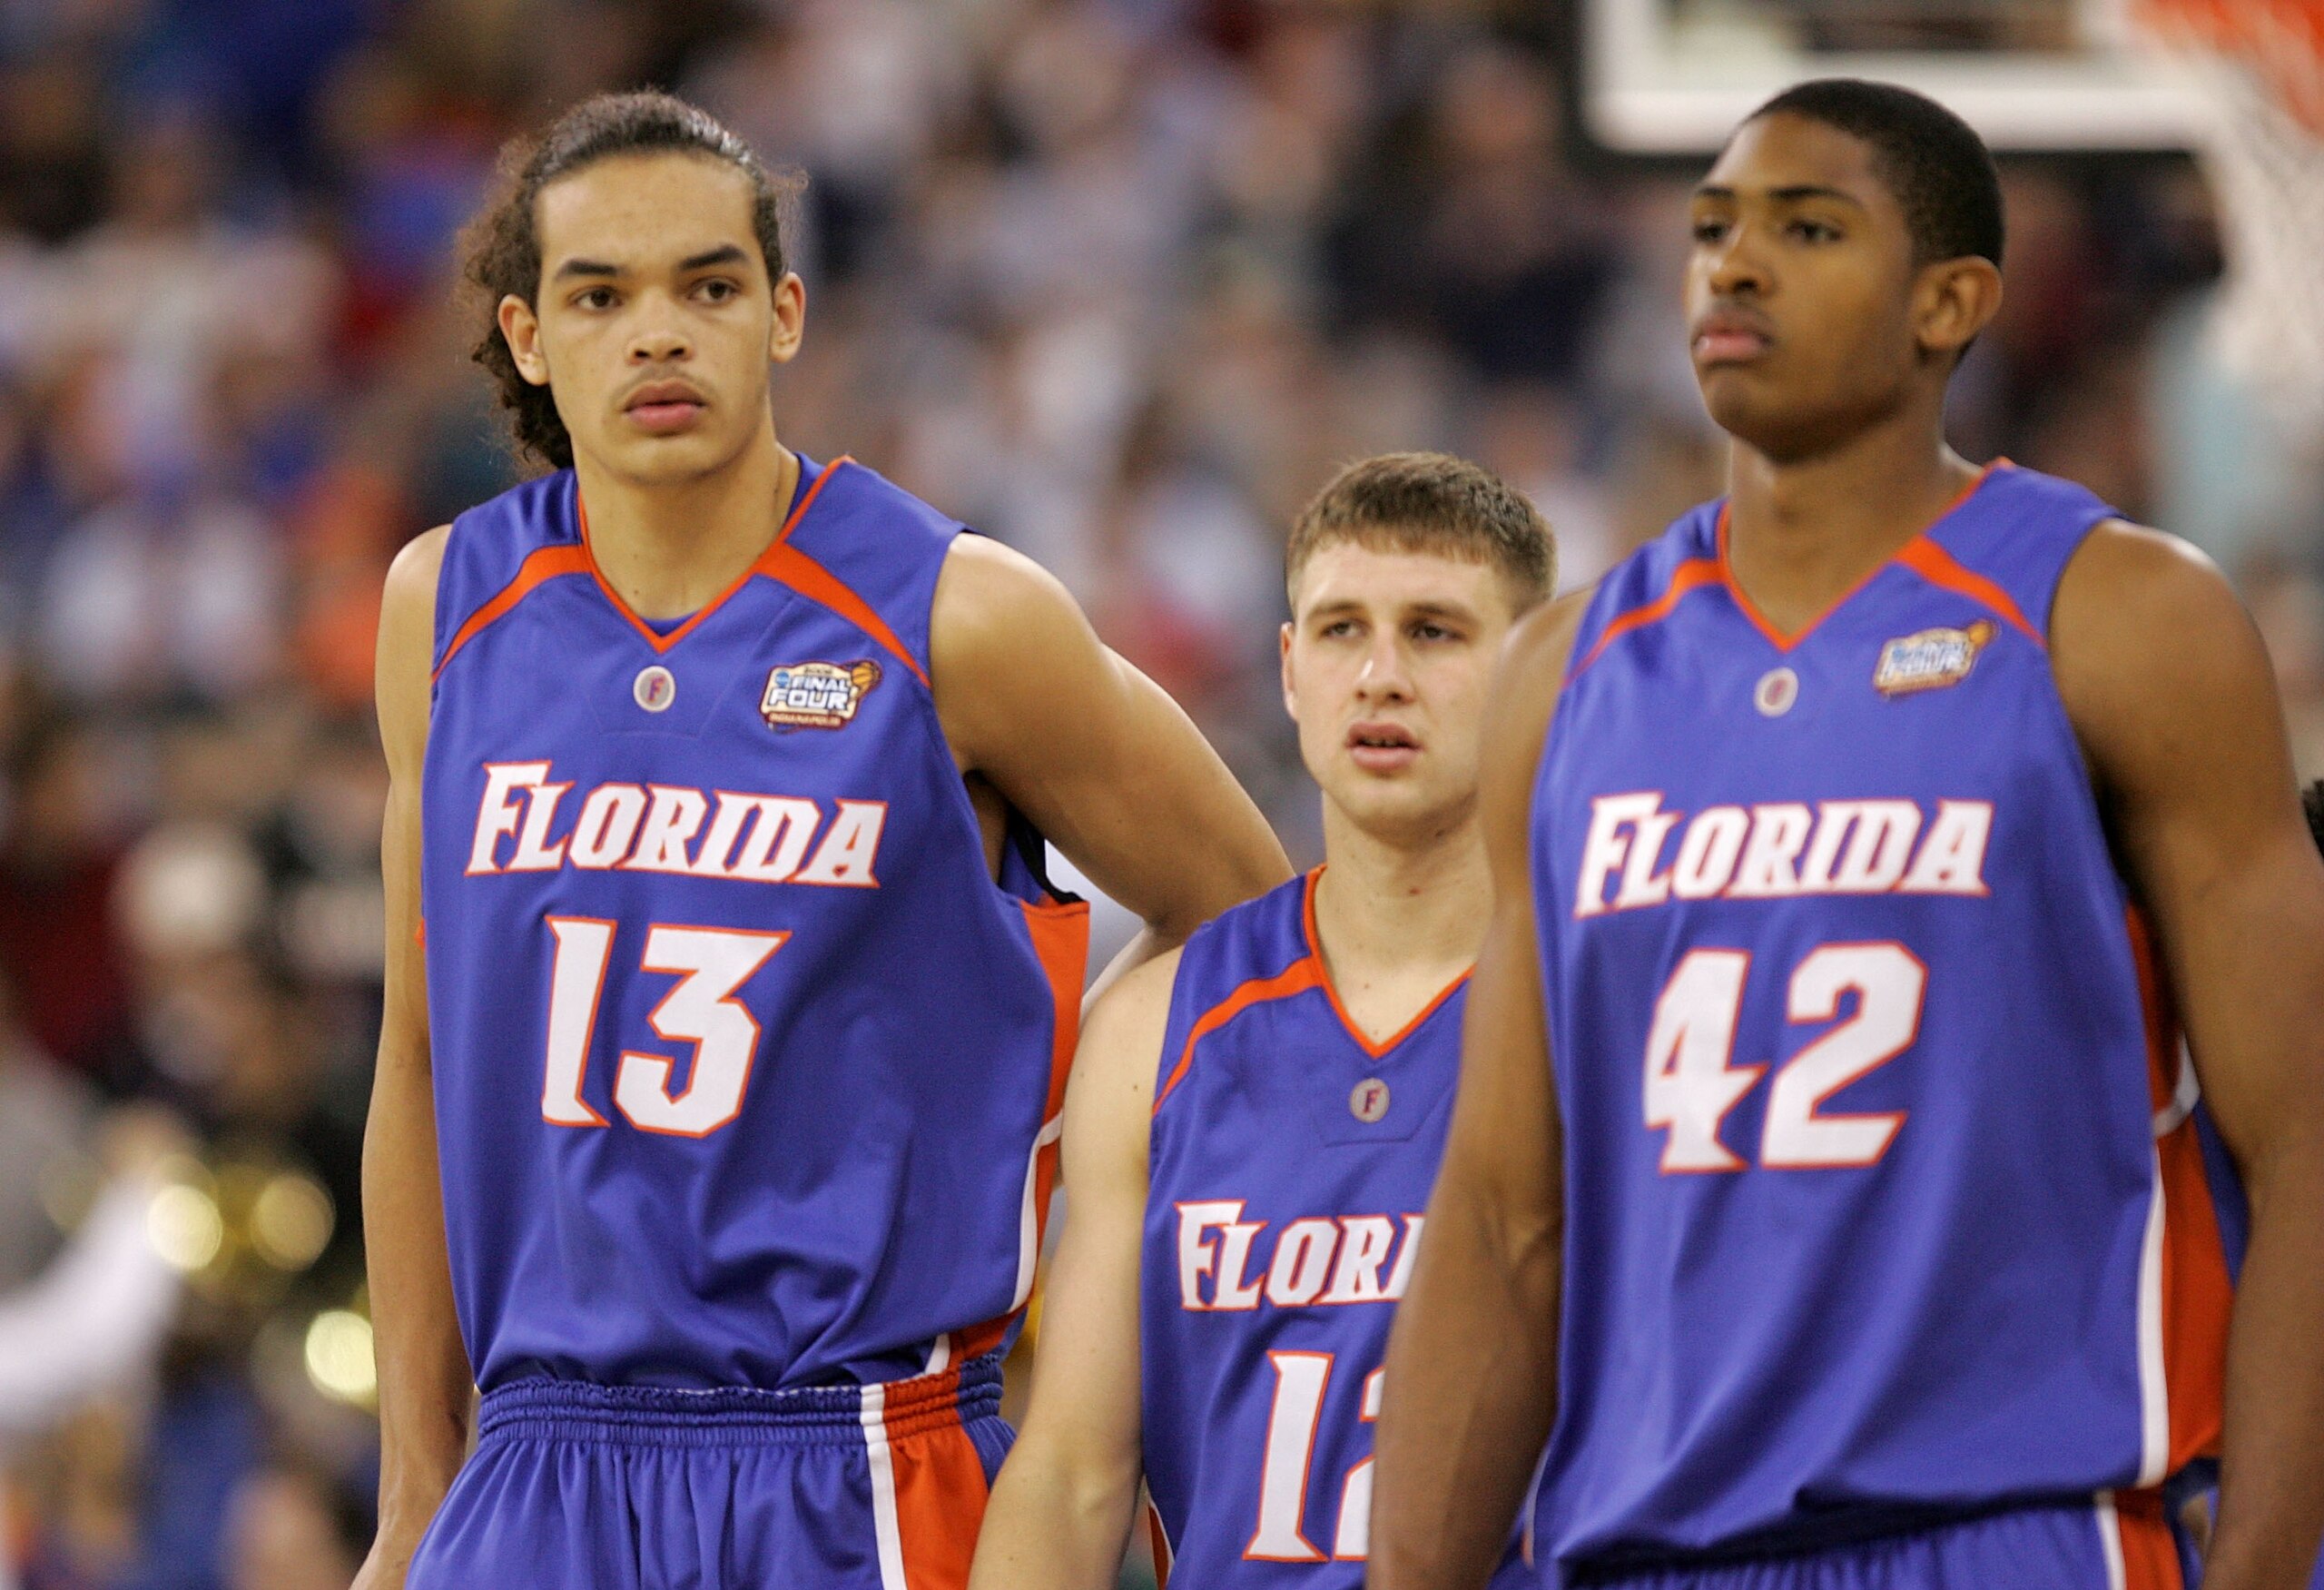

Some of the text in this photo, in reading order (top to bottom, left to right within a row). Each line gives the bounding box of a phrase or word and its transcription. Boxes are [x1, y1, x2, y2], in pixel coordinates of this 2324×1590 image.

[647, 675, 666, 703] F
[767, 688, 850, 710] FOUR
[791, 676, 851, 693] FINAL
[464, 760, 889, 888] FLORIDA
[1573, 791, 1994, 921] FLORIDA
[541, 915, 793, 1139] 13
[1642, 940, 1929, 1177] 42
[1364, 1087, 1383, 1115] F
[1173, 1199, 1427, 1311] FLORI
